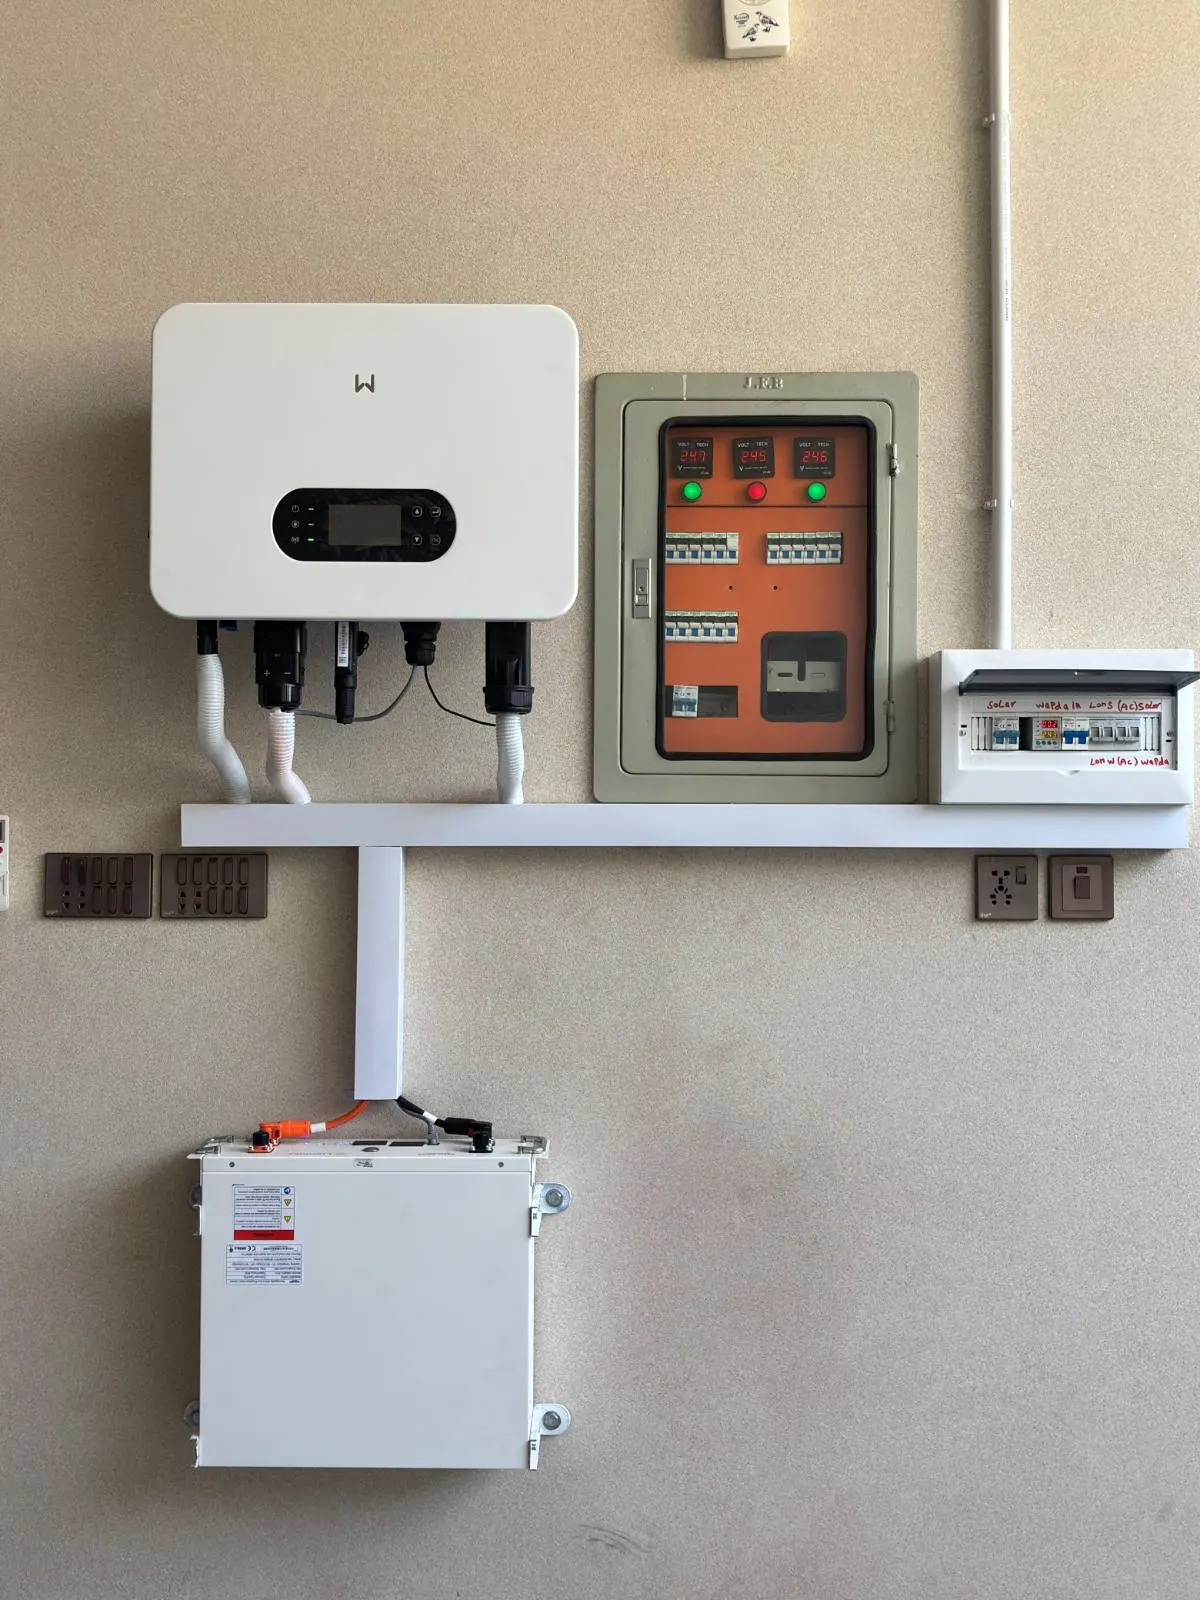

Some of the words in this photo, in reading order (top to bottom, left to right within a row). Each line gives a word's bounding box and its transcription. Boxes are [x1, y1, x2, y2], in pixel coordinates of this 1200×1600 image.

[680, 450, 706, 461] 247
[741, 450, 767, 463] 245
[802, 450, 828, 463] 246
